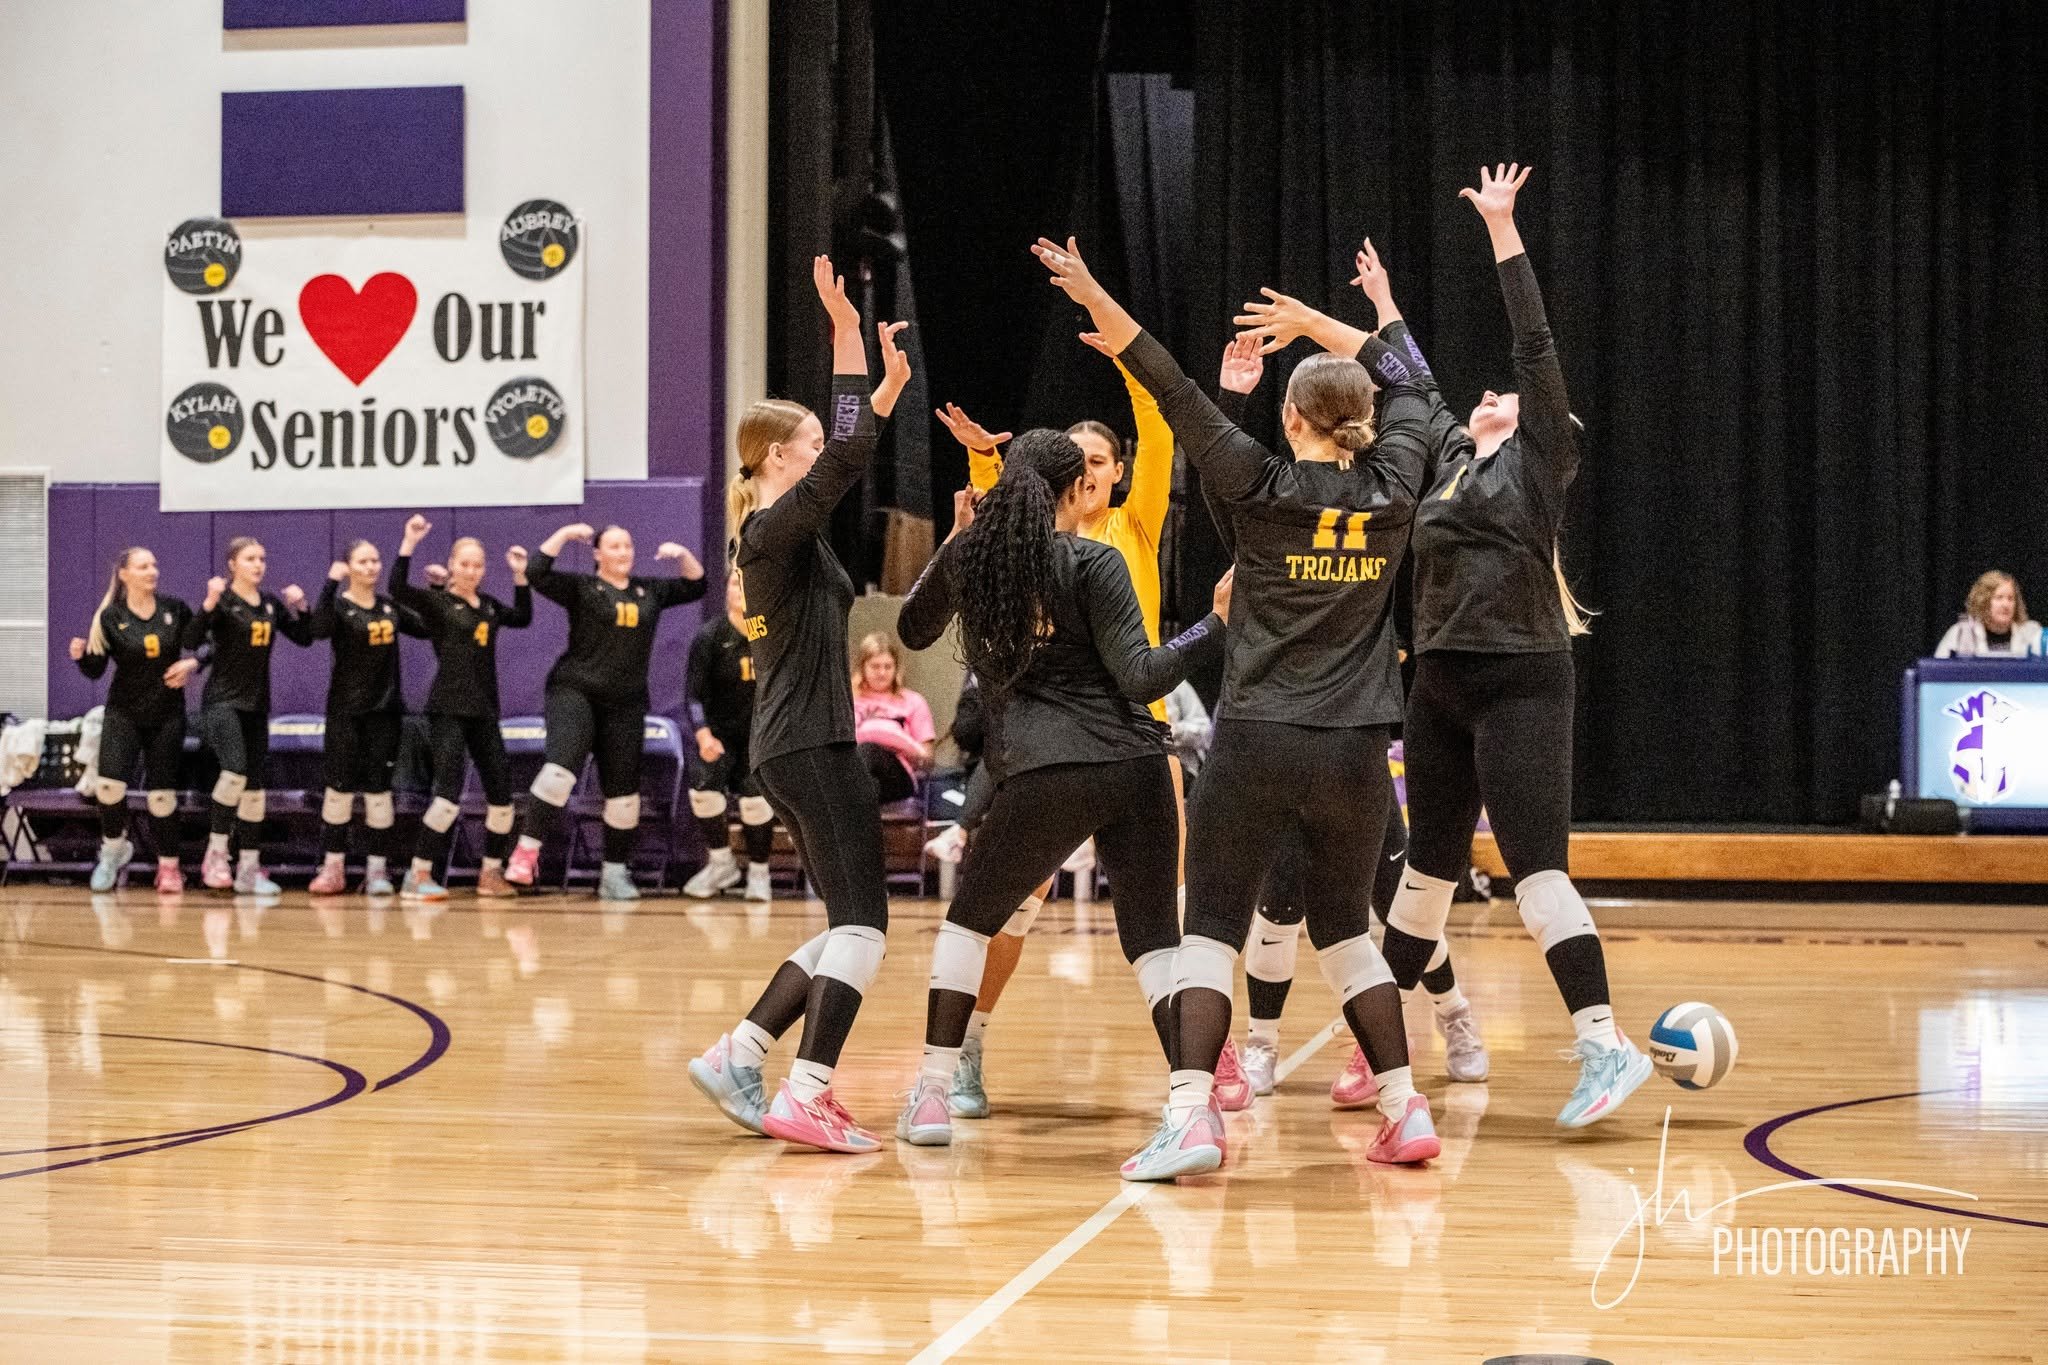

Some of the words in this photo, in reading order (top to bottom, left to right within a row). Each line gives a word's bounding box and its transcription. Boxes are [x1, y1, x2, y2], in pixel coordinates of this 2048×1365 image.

[502, 210, 581, 241] AUBREY
[196, 299, 285, 368] We
[433, 292, 546, 363] Our
[170, 394, 237, 423] KYLAH
[251, 398, 476, 471] Seniors
[1312, 508, 1372, 550] 11
[1285, 555, 1387, 582] TROJANS
[143, 633, 160, 658] 9
[251, 620, 271, 647] 21
[367, 619, 394, 646] 22
[473, 621, 489, 647] 4
